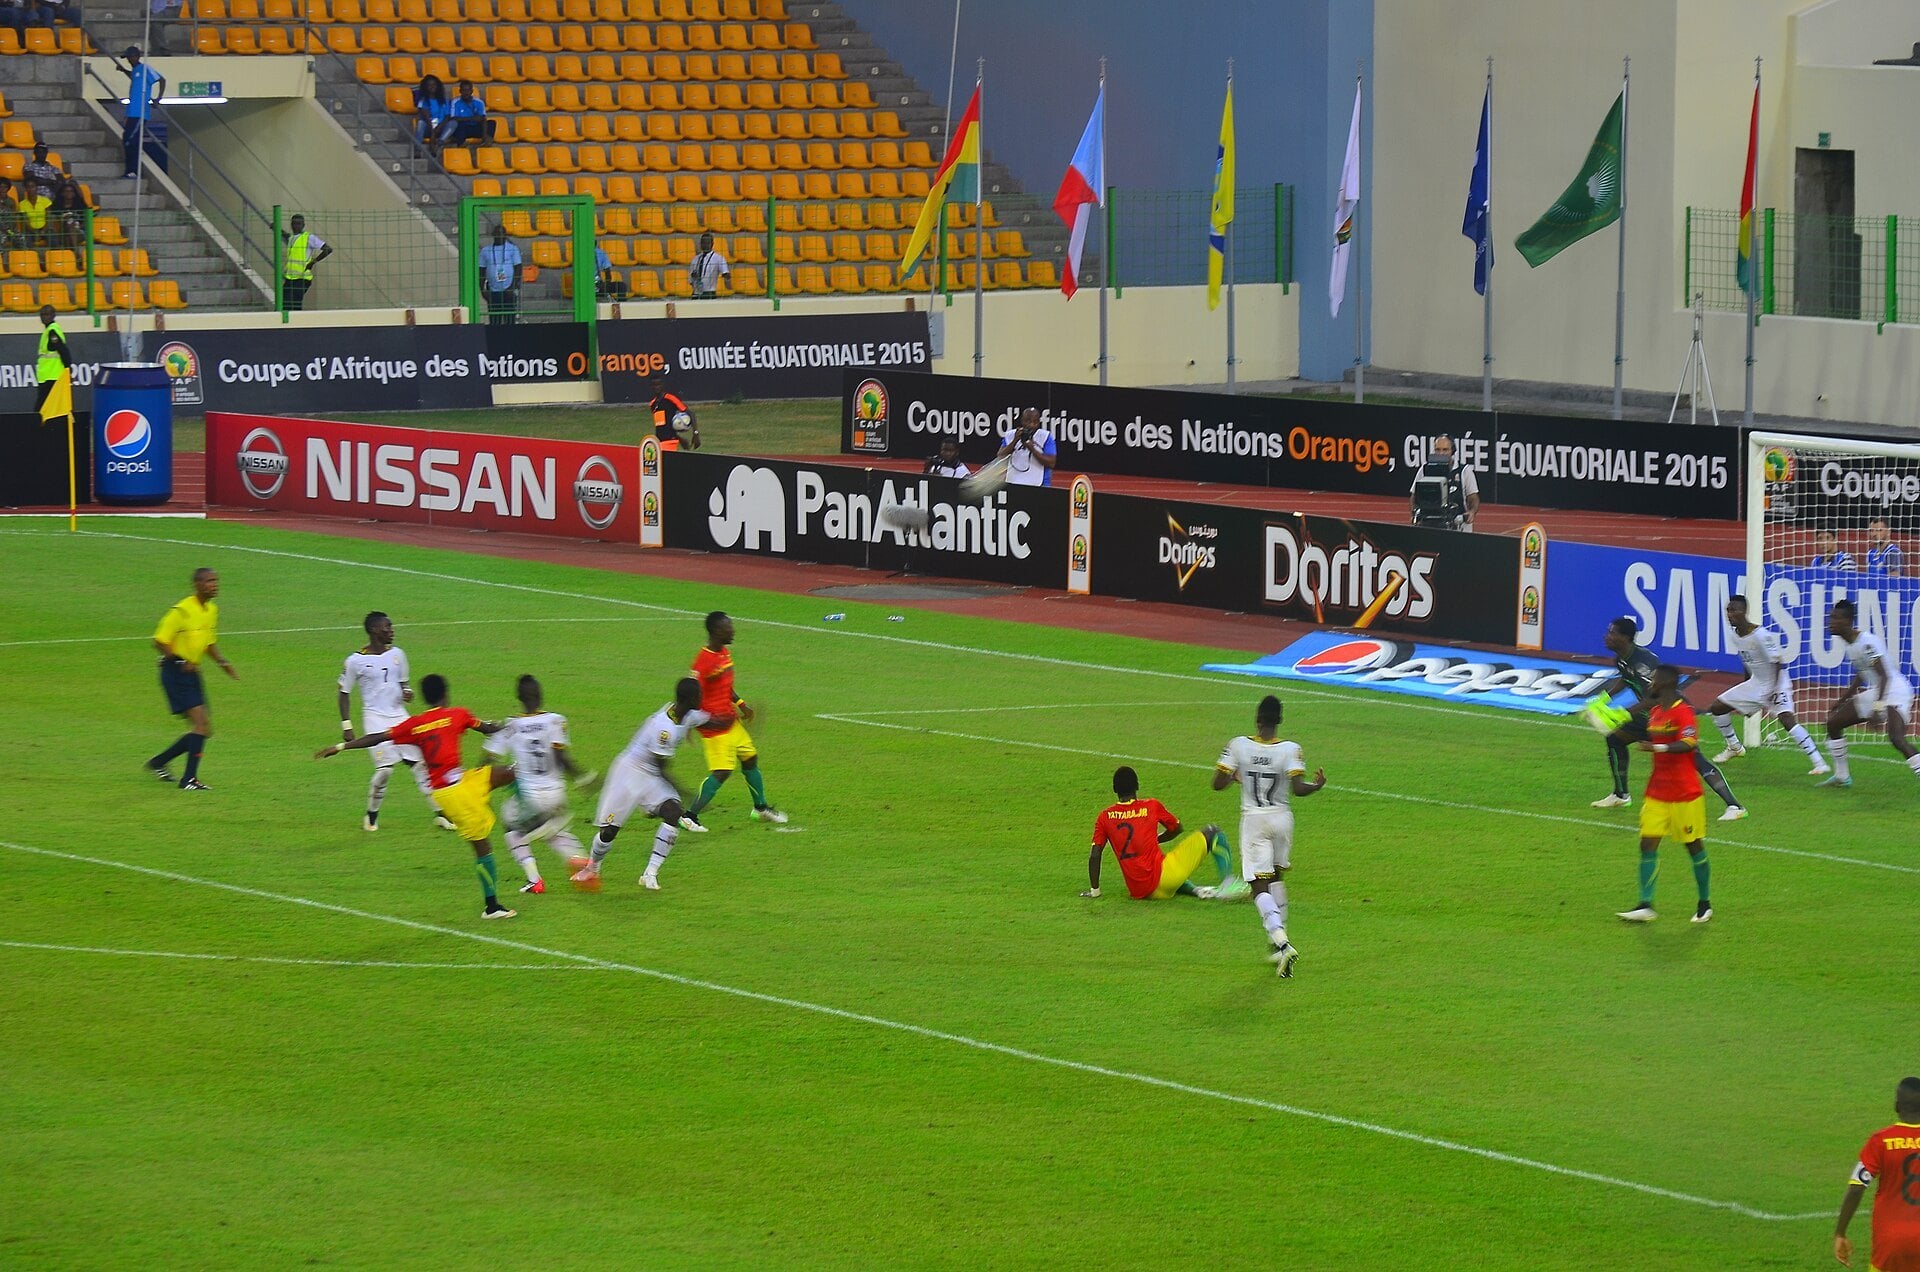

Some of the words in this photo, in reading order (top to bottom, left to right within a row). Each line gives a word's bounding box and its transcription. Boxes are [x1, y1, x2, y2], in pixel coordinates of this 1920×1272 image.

[219, 359, 301, 387] Coupe
[425, 354, 469, 377] des
[478, 353, 558, 378] Nations
[679, 341, 746, 370] GUINÉE
[751, 340, 874, 370] ÉQUATORIALE
[880, 341, 926, 365] 2015
[859, 420, 881, 429] CAF
[241, 456, 285, 470] NISSAN
[907, 401, 991, 443] Coupe
[997, 407, 1117, 451] d’frique
[1124, 416, 1173, 450] des
[1181, 418, 1284, 459] Nations
[1288, 426, 1396, 473] Orange,
[1496, 433, 1659, 485] ÉQUATORIALE
[1665, 453, 1728, 490] 2015
[107, 460, 151, 475] pepsi
[306, 437, 556, 520] NISSAN
[1821, 462, 1920, 508] Coupe
[578, 485, 619, 499] NISSAN
[797, 471, 1031, 559] PanAtlantic
[1159, 537, 1216, 568] Doritos
[1265, 526, 1434, 618] Doritos
[381, 667, 389, 684] 7
[1246, 770, 1279, 807] 17
[1117, 822, 1140, 859] 2
